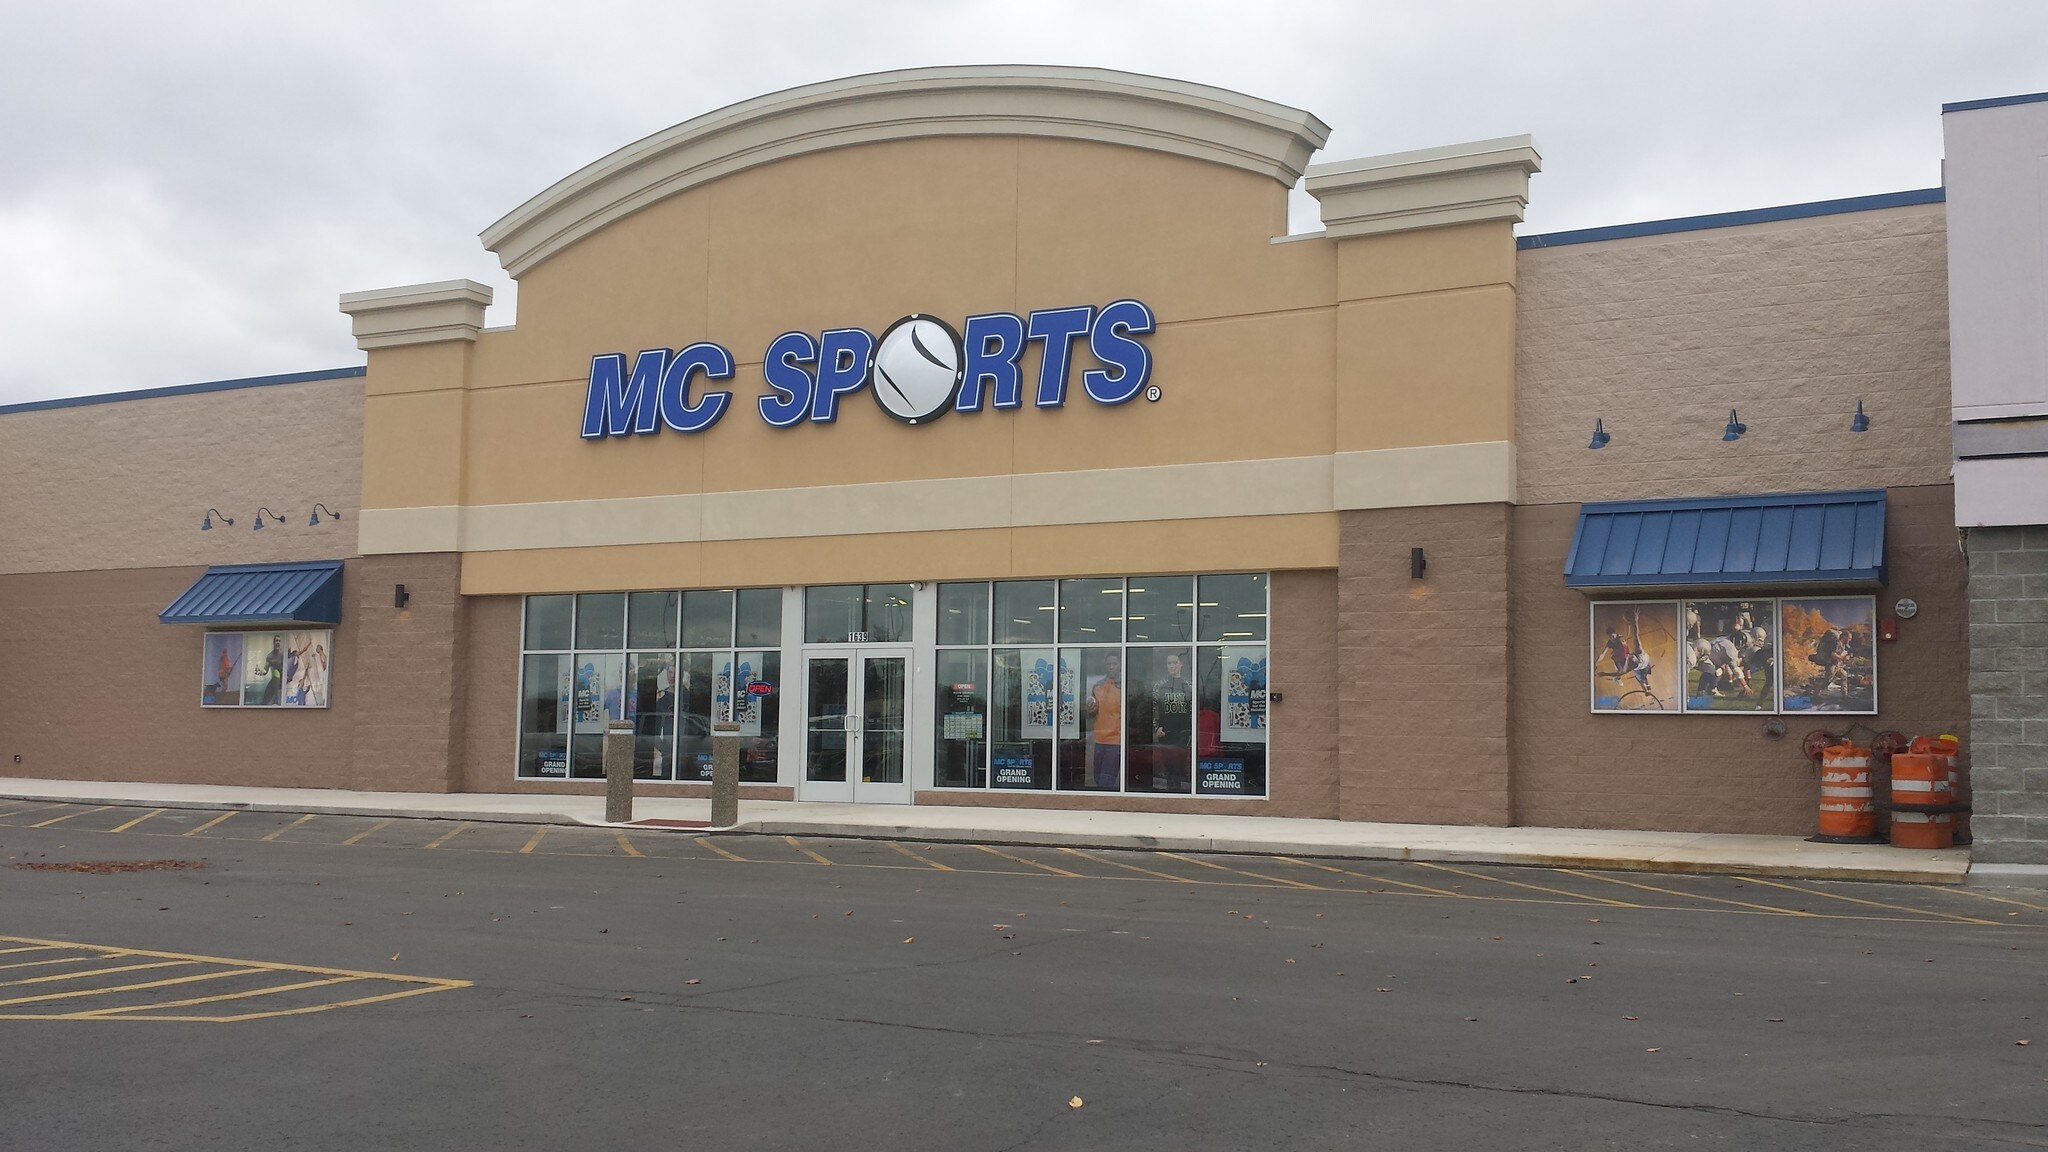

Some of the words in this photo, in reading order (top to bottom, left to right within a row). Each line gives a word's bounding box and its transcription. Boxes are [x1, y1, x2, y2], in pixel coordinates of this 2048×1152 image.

[580, 342, 735, 441] MC
[758, 299, 1156, 428] SPORTS
[849, 632, 868, 642] 1639
[748, 684, 772, 693] OPEN
[1164, 692, 1186, 702] JUST
[1250, 689, 1266, 699] MC
[1164, 702, 1177, 714] DO
[1199, 762, 1212, 770] MC
[996, 775, 1031, 783] OPENING
[1206, 773, 1236, 781] GRAND
[1202, 780, 1241, 789] OPENING
